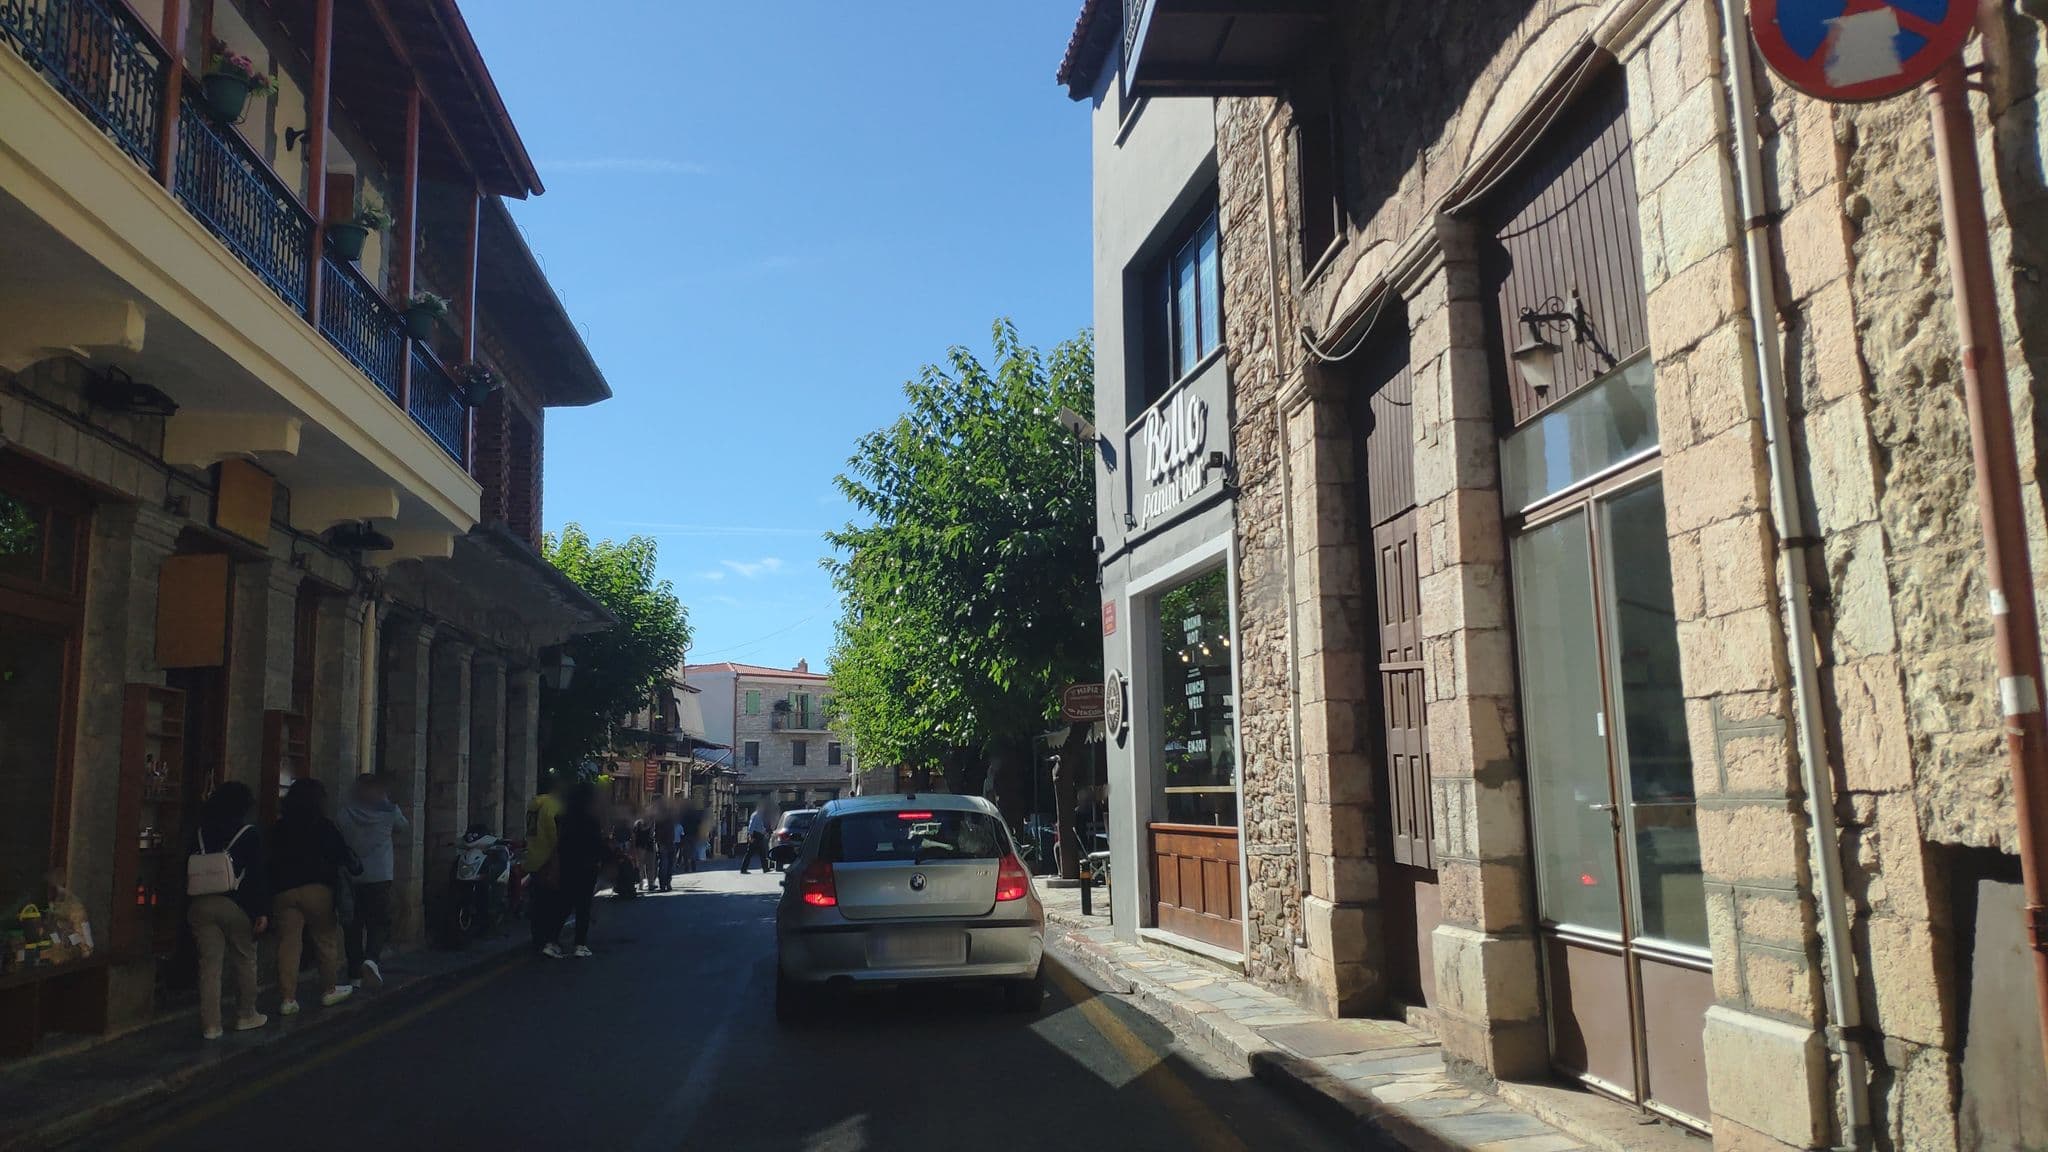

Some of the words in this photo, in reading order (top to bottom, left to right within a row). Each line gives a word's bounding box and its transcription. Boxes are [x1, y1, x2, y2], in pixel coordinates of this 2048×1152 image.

[1144, 388, 1206, 481] Bello
[1142, 471, 1181, 529] panini
[1181, 458, 1204, 504] bar
[1185, 680, 1205, 695] LUNCH
[1188, 696, 1203, 710] WELL
[1188, 739, 1206, 753] ENJOY
